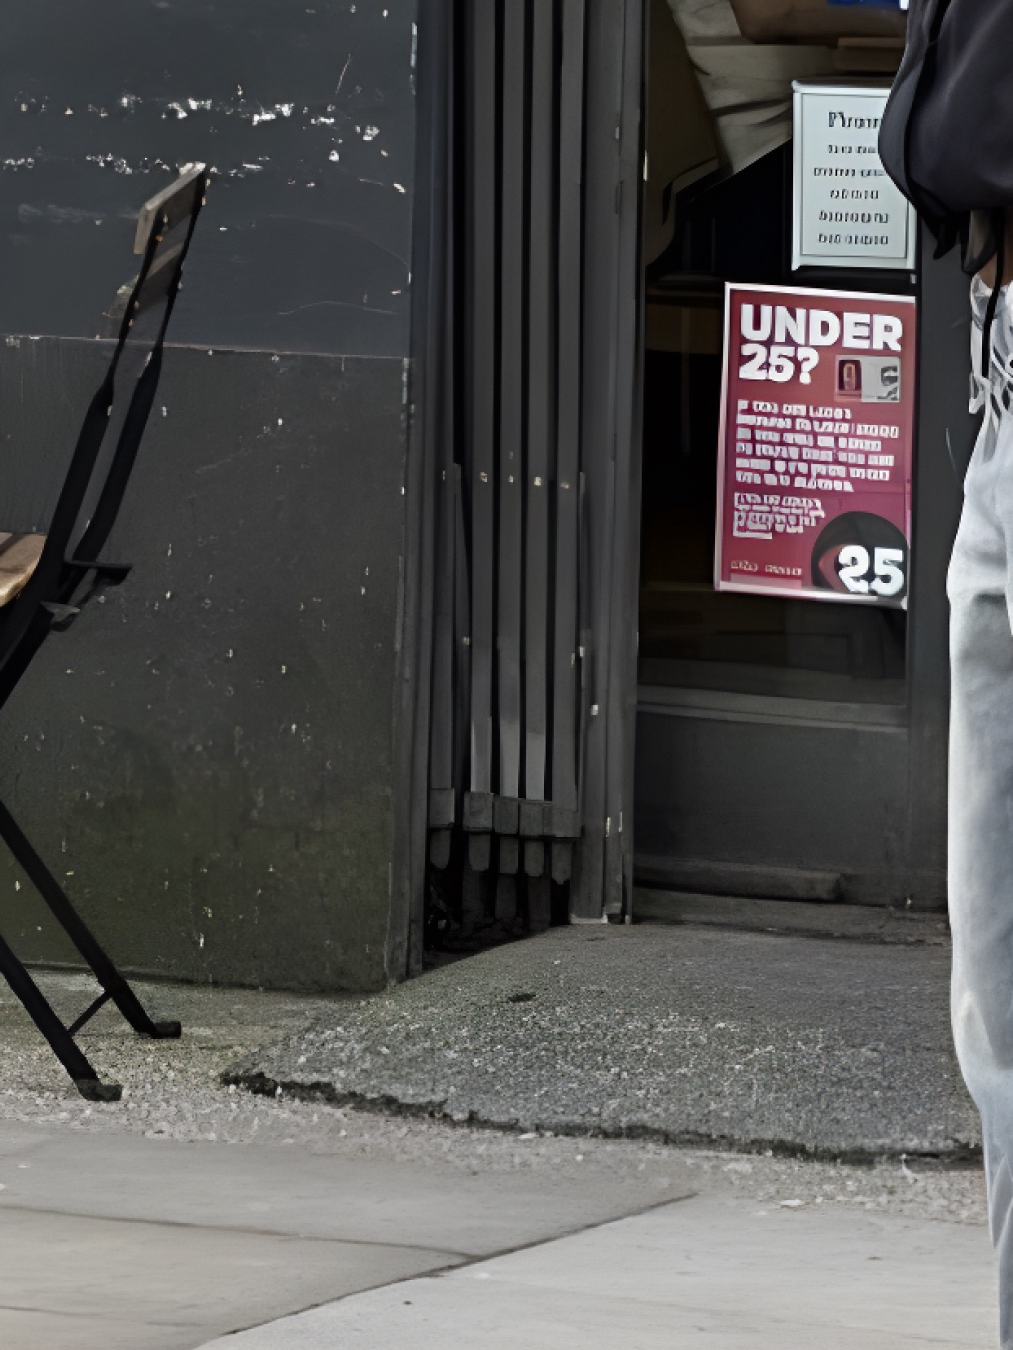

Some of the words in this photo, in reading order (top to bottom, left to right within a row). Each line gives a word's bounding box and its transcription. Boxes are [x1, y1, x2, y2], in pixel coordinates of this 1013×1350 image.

[740, 303, 903, 352] UNDER
[739, 343, 819, 384] 25?
[838, 544, 904, 596] 25
